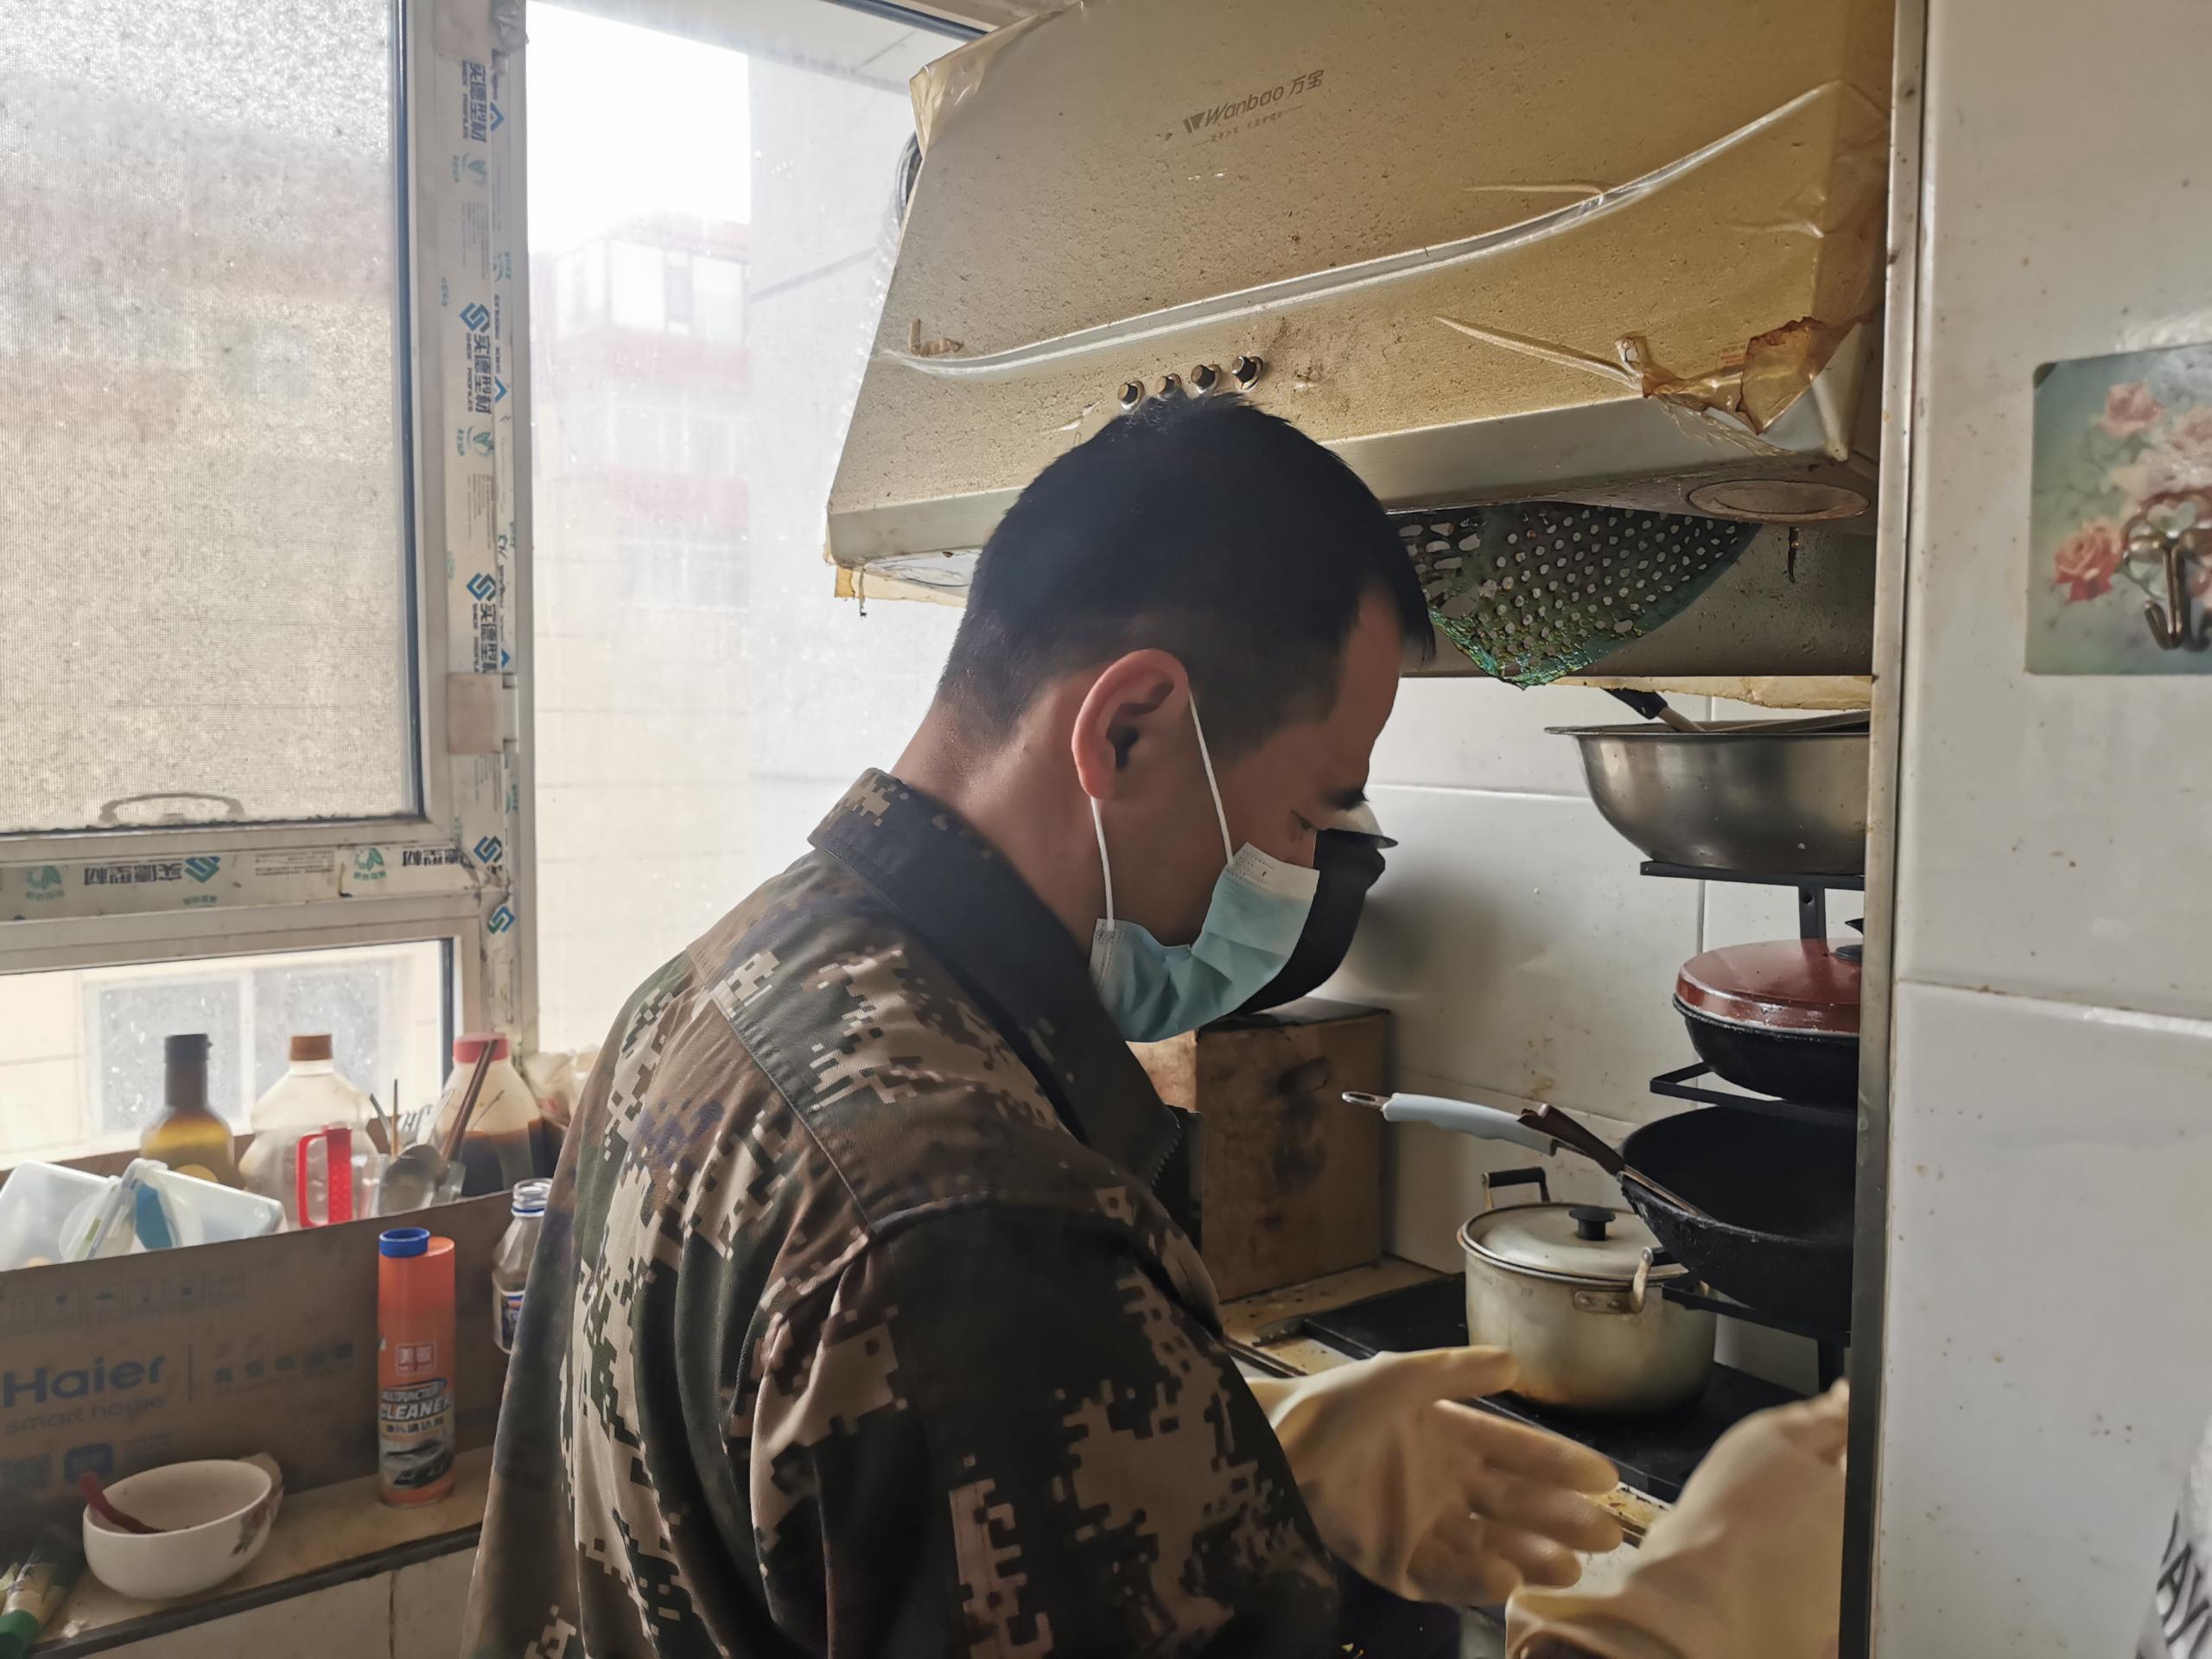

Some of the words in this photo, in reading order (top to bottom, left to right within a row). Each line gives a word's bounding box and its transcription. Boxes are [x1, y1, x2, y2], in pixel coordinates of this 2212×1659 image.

[1205, 86, 1285, 127] Wanbao
[1289, 69, 1325, 97] 万宝
[474, 334, 493, 415] 实德型材
[84, 862, 183, 886] 实德型材
[2, 1354, 165, 1408] Haier
[5, 1401, 83, 1435] smart
